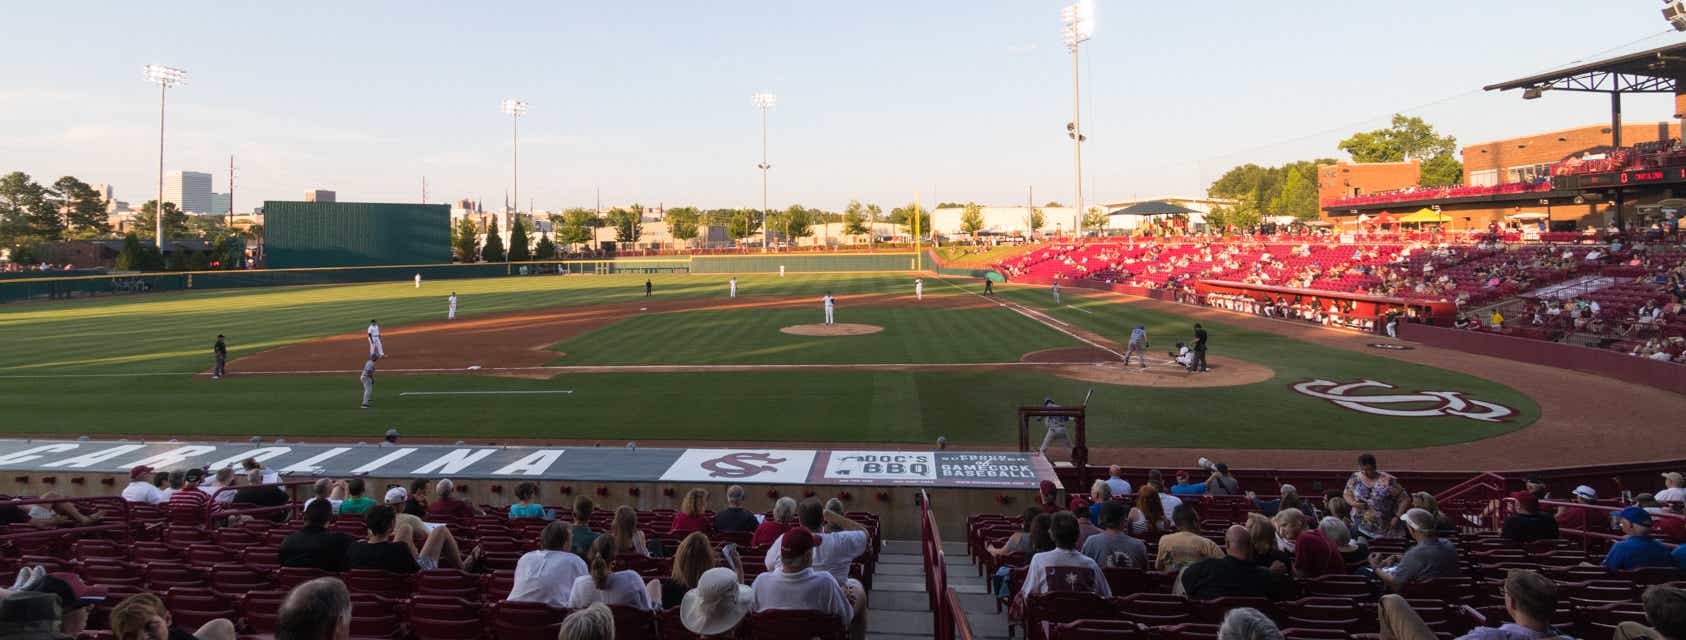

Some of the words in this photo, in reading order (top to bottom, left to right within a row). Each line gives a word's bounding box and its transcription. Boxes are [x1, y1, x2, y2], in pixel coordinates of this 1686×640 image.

[0, 443, 565, 476] CAROLINA
[863, 463, 929, 476] BBQ
[941, 464, 1031, 472] GAMECOCK
